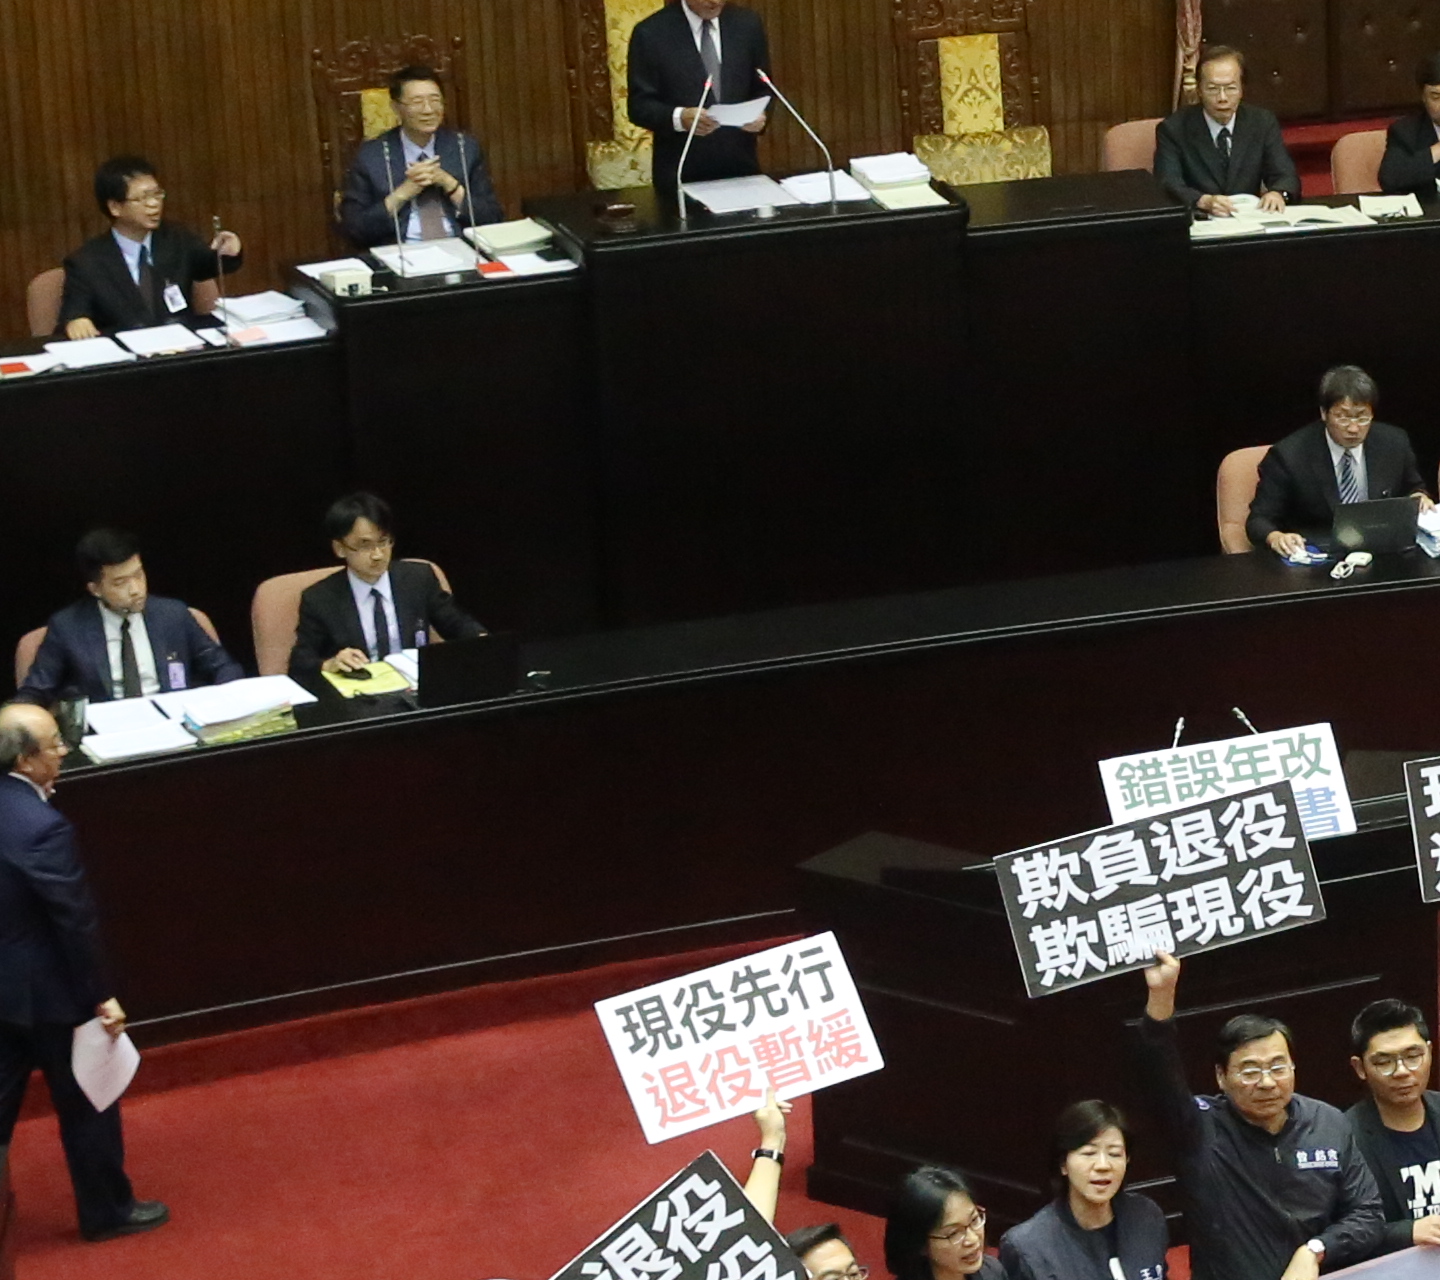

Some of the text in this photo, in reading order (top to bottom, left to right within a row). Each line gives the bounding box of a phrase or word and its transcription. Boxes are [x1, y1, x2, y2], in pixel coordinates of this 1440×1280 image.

[1114, 730, 1332, 810] 錯誤年改
[1011, 792, 1296, 919] 欺負退役
[1029, 859, 1315, 988] 欺騙現役
[615, 945, 834, 1058] 現役先行
[642, 1007, 869, 1129] 退役暫緩
